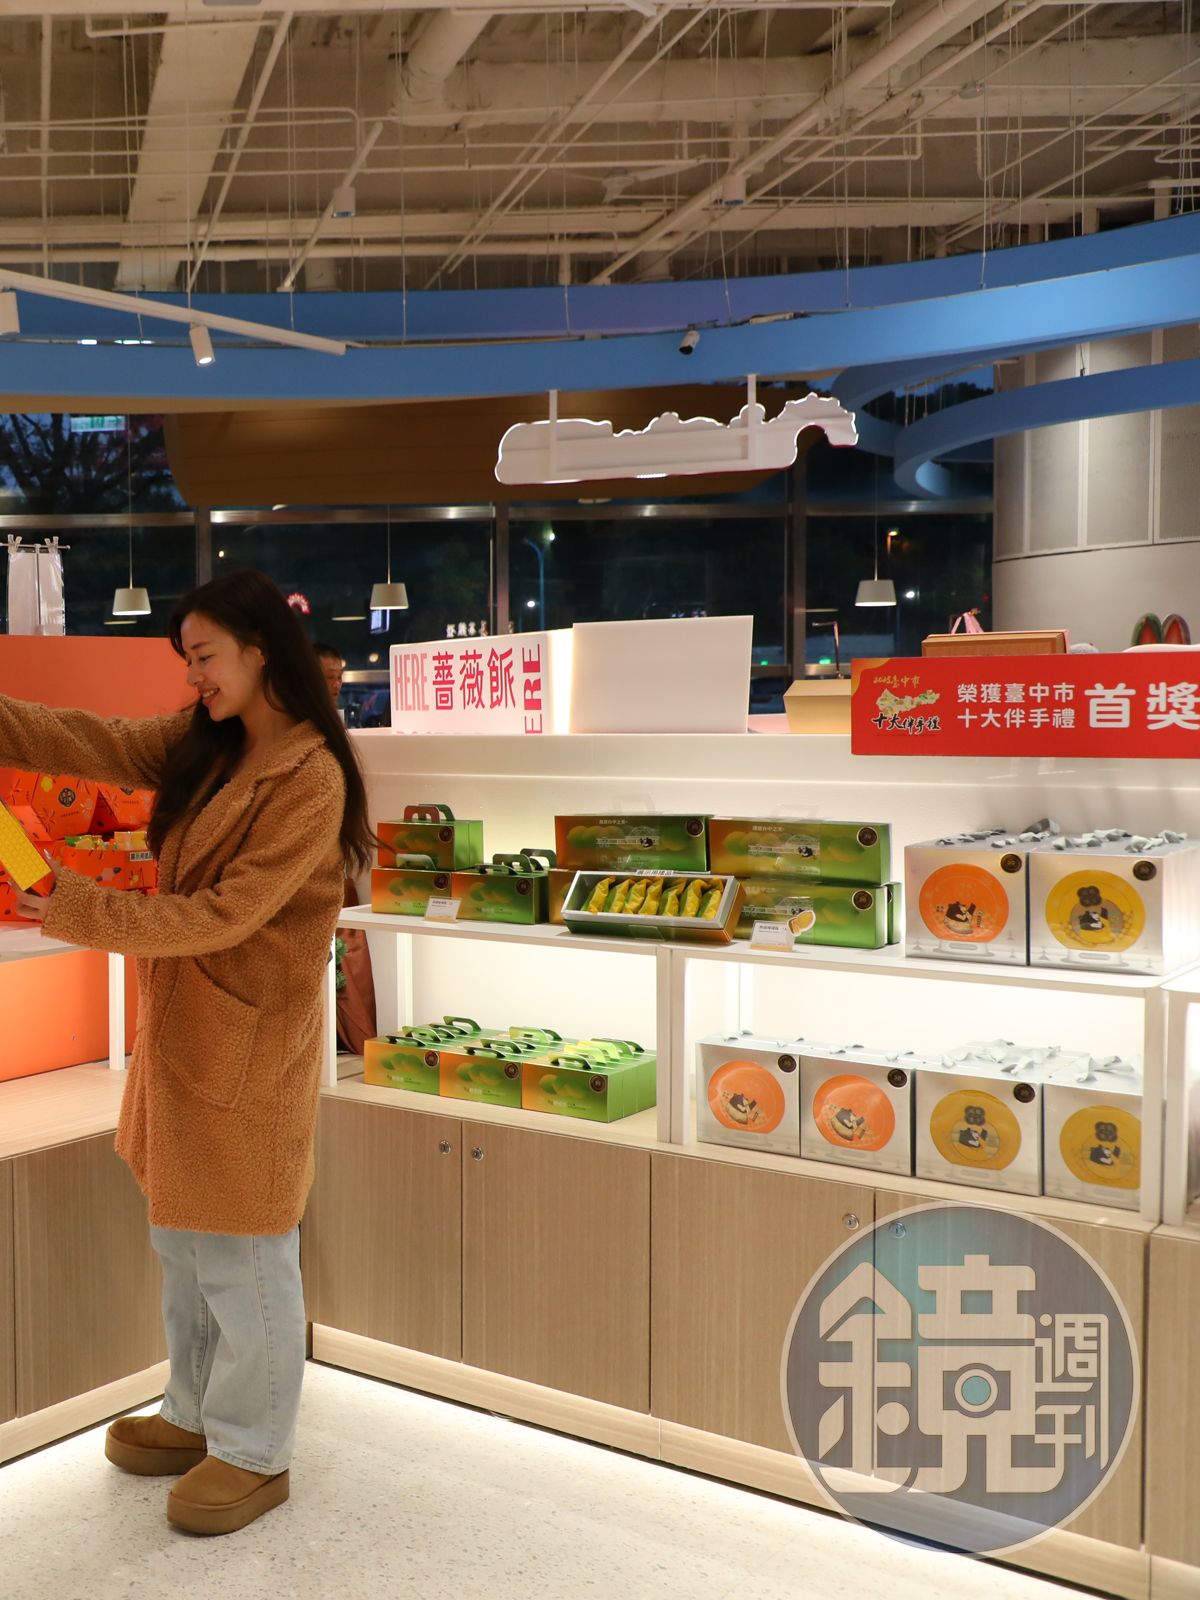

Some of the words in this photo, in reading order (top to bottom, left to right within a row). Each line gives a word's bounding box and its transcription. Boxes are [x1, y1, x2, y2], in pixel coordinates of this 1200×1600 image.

[394, 653, 430, 711] HERE
[957, 683, 1075, 703] 榮獲臺中市
[957, 708, 1076, 729] 十大伴手禮
[1084, 682, 1200, 730] 首獎
